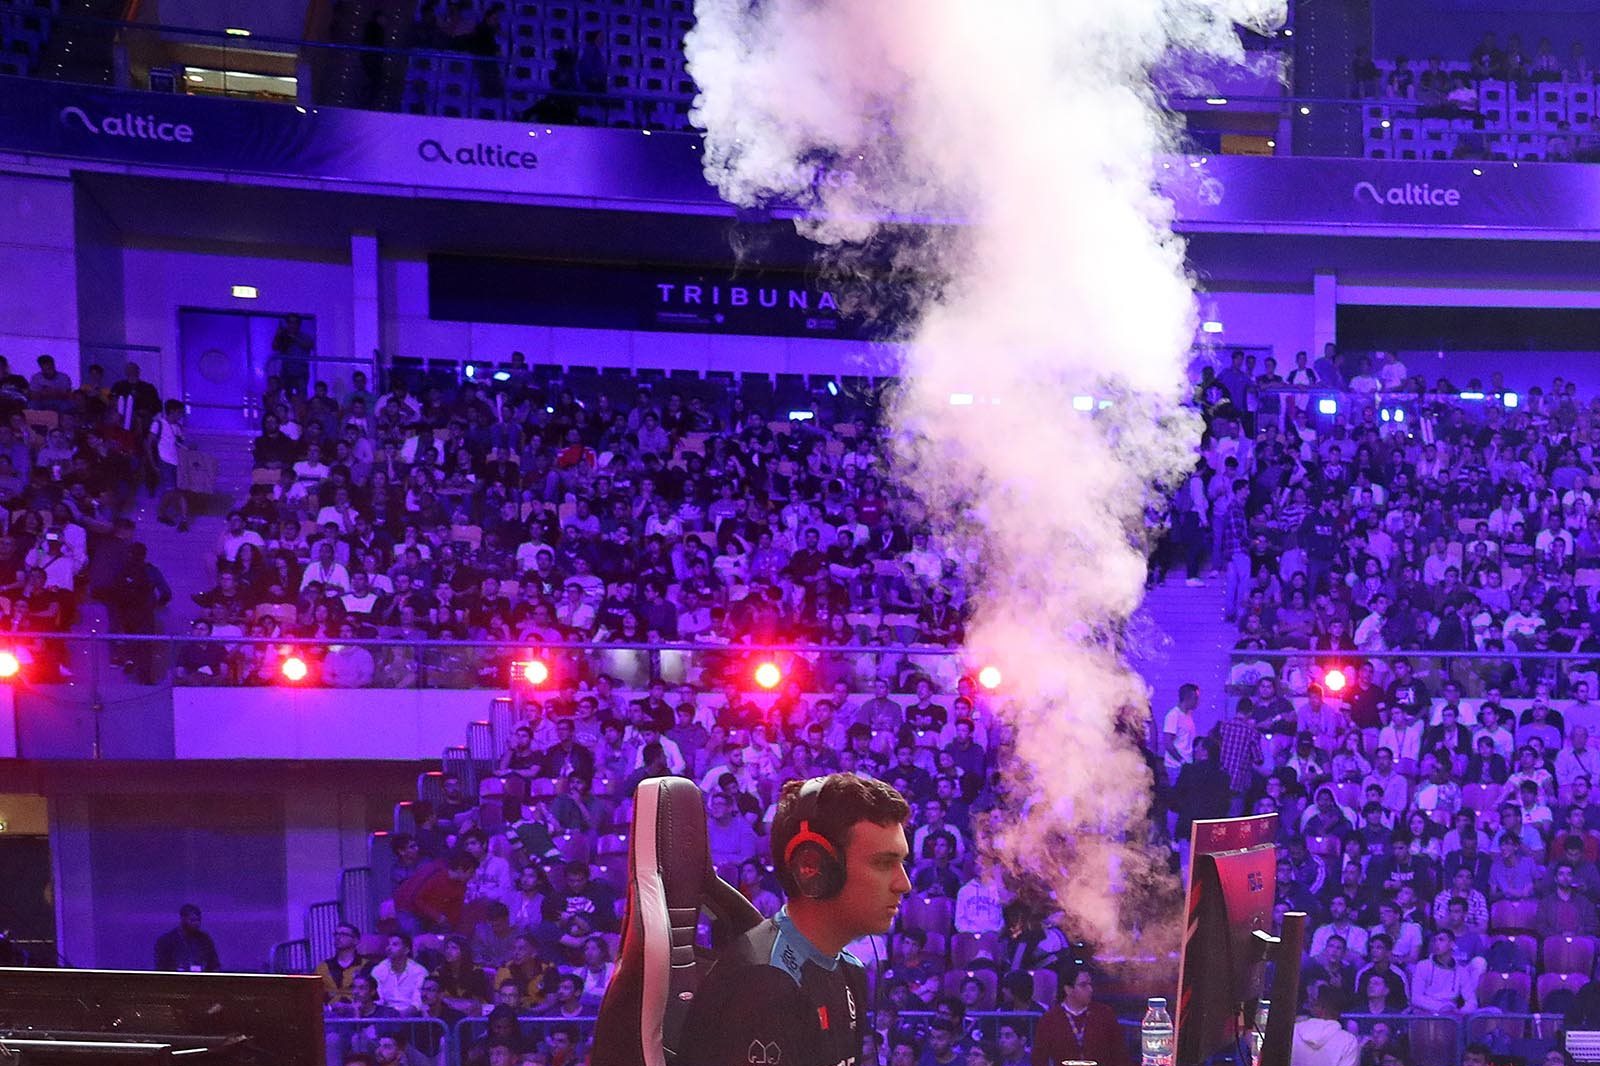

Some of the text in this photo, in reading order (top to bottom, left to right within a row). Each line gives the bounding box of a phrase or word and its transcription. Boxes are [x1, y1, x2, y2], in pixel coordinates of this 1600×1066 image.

[102, 112, 193, 142] altice
[456, 143, 538, 169] altice
[1386, 183, 1460, 206] altice
[657, 283, 838, 310] TRIBUNA
